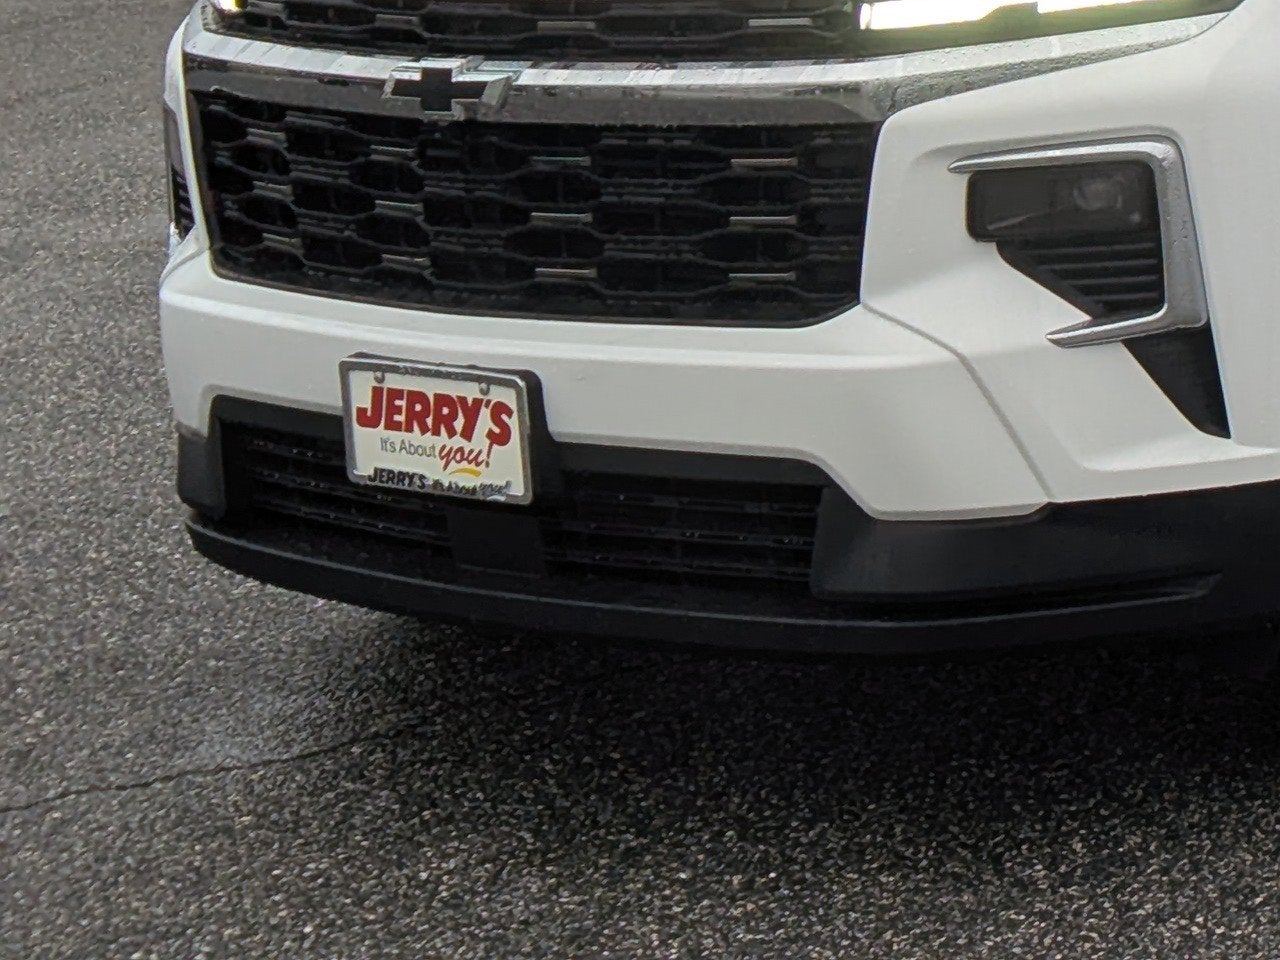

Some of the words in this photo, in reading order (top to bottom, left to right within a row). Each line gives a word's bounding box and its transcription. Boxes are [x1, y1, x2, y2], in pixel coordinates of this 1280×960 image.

[355, 385, 515, 447] JERRY'S
[380, 436, 397, 453] It's
[399, 438, 436, 459] About
[438, 440, 494, 471] you!
